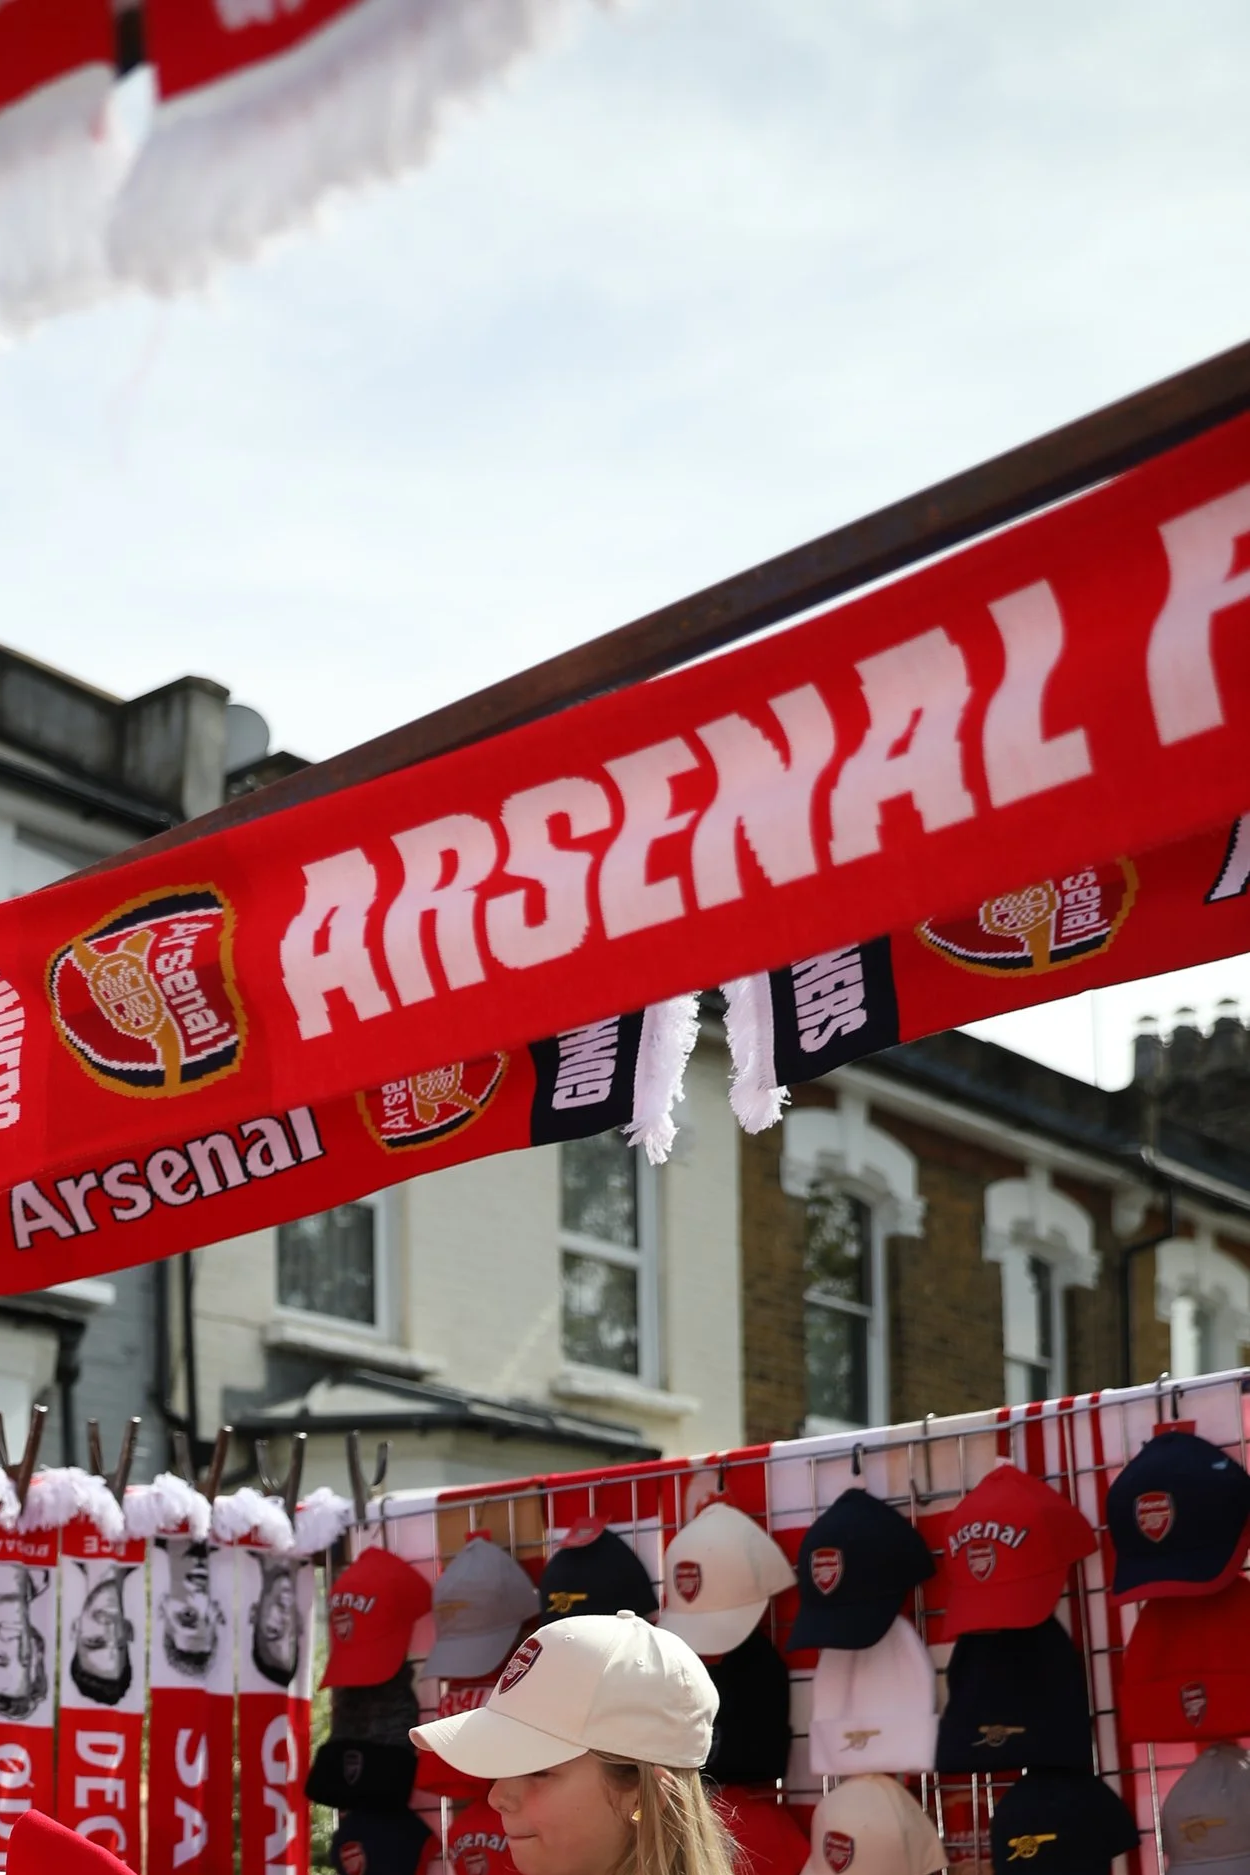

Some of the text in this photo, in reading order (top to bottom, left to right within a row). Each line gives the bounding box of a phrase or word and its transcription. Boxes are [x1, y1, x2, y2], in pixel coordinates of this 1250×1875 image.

[279, 578, 1095, 1042] ARSENAL
[153, 916, 233, 1048] Arsenal
[10, 1106, 326, 1251] Arsenal
[948, 1520, 1029, 1559] Arsenal
